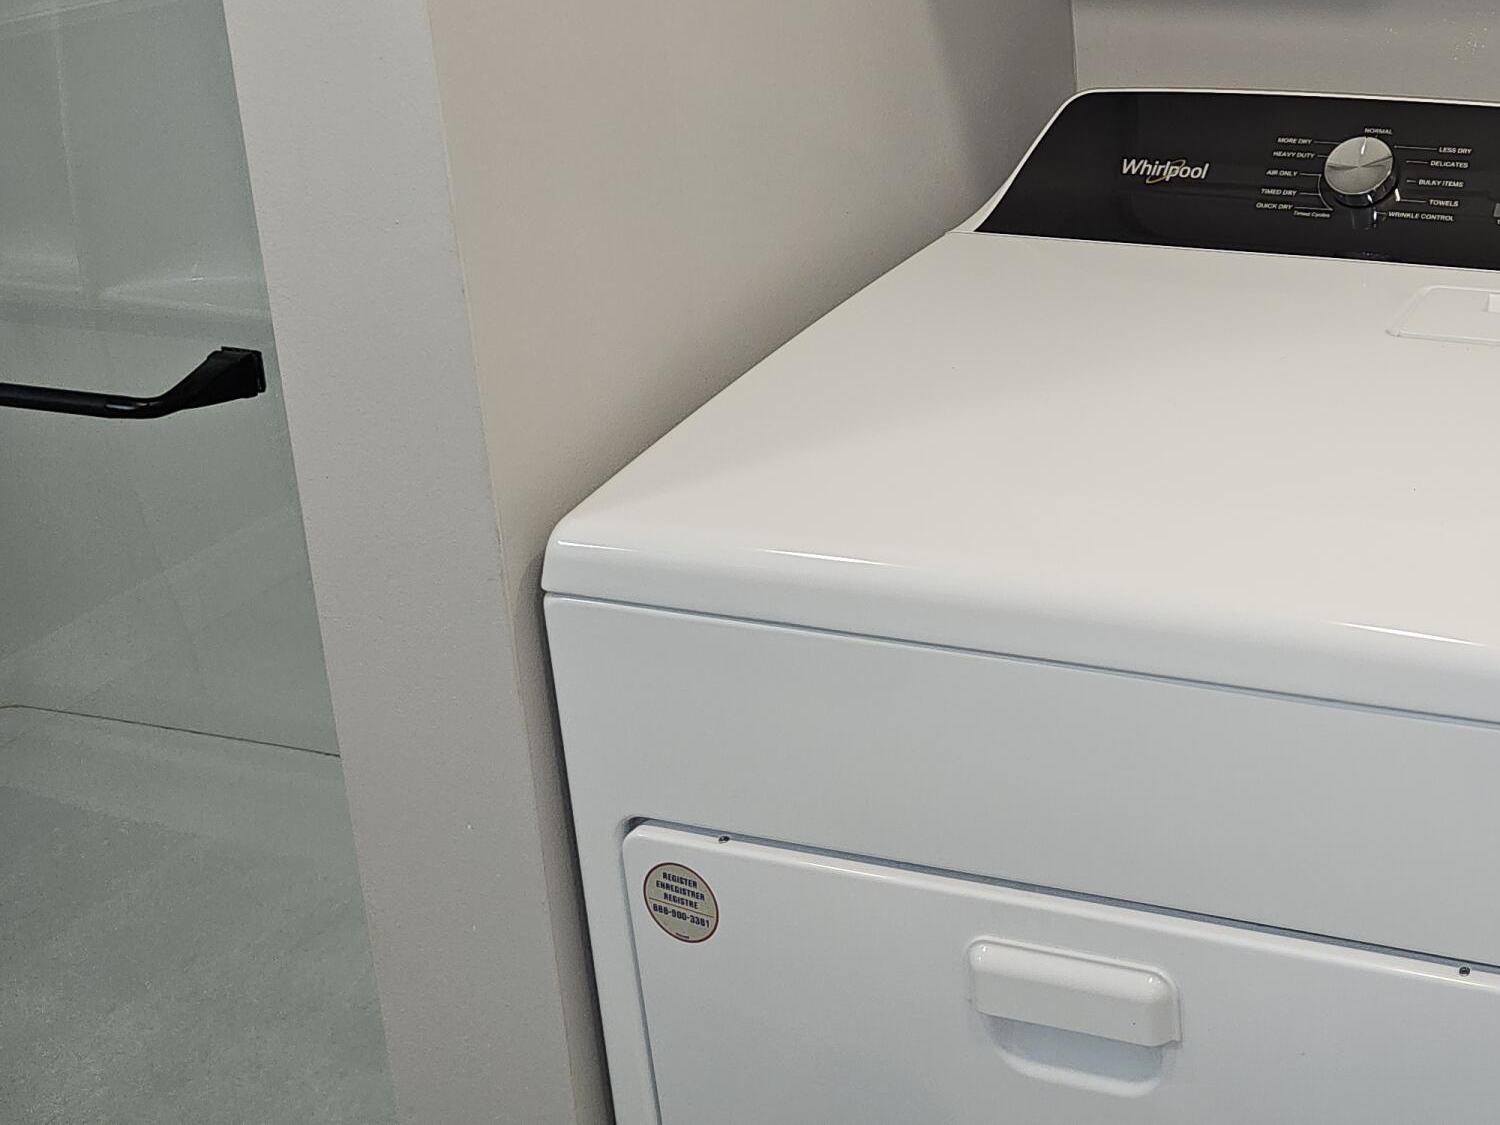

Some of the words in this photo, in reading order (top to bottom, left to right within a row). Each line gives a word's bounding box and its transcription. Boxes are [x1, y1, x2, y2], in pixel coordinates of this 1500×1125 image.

[1364, 127, 1393, 135] NORMAL
[1272, 150, 1296, 158] HEAVY
[1296, 152, 1316, 160] DUTY
[1430, 160, 1468, 168] DELICATES
[1122, 158, 1210, 183] Whirlpool
[1418, 178, 1442, 186] BULKY
[1442, 180, 1464, 188] ITEMS
[1255, 202, 1278, 210] QUICK
[1429, 199, 1460, 208] TOWELS
[1388, 211, 1420, 220] WRINKLE
[1420, 213, 1455, 222] CONTROL
[662, 872, 698, 889] REGISTER
[656, 880, 705, 902] ENREGISTRER
[663, 892, 698, 910] REGISTRE
